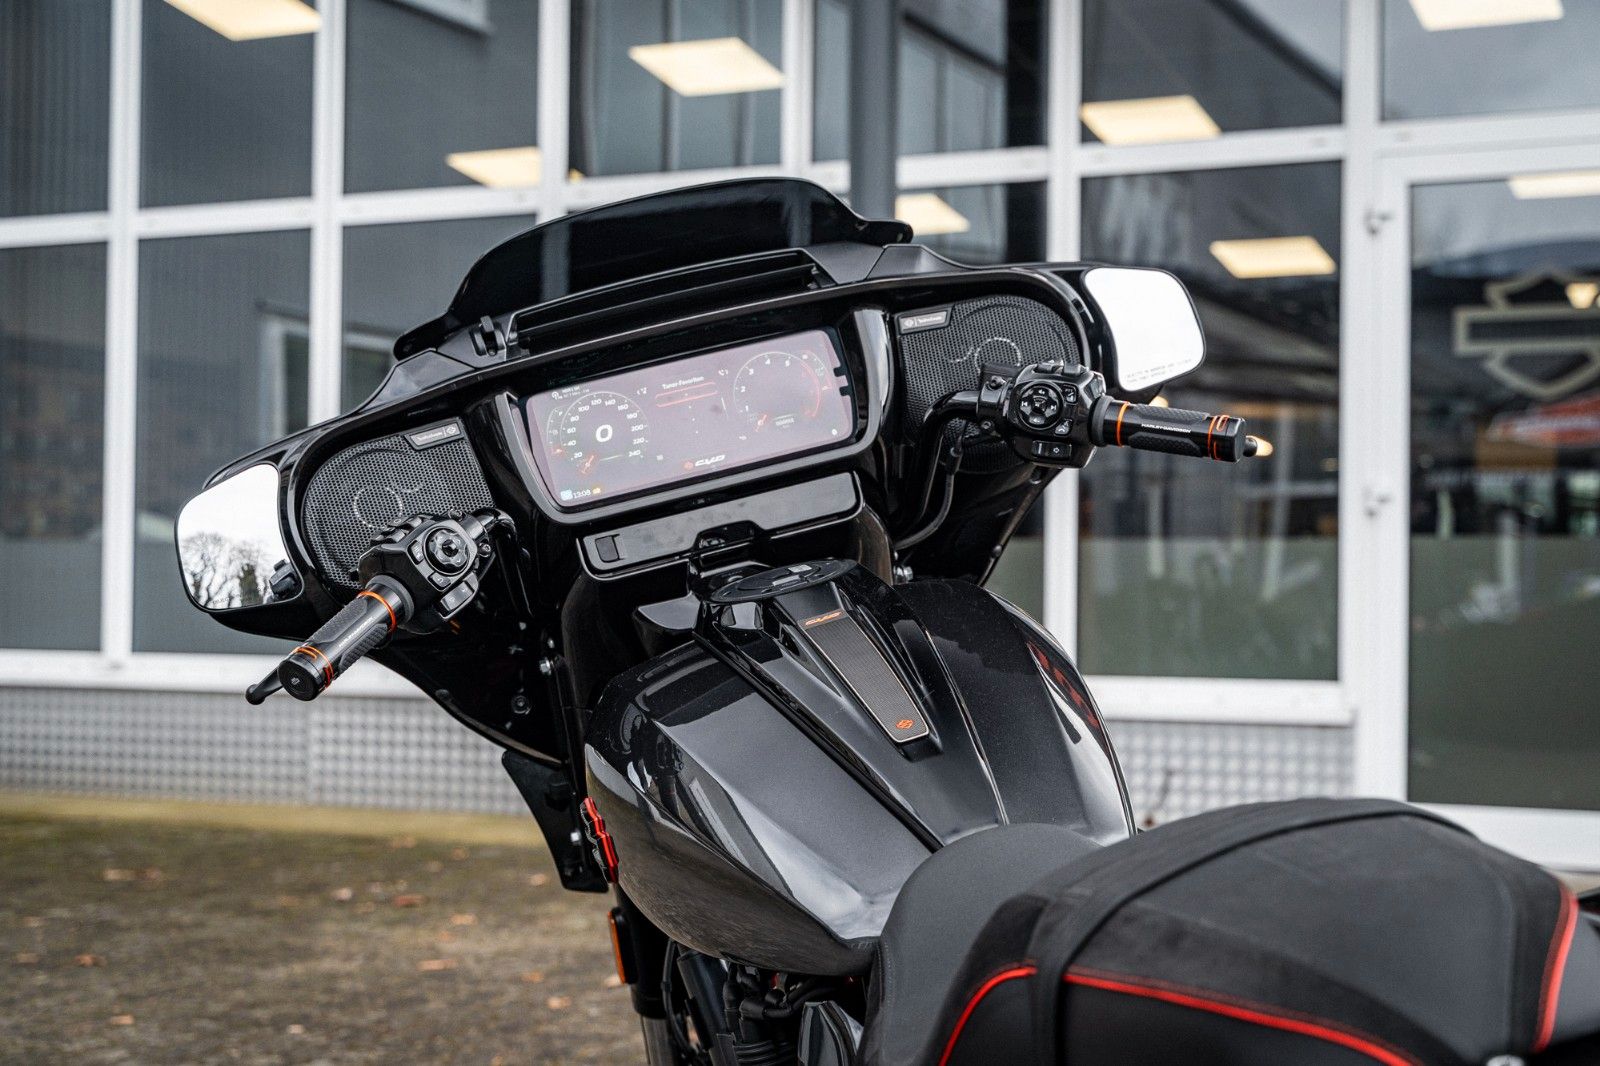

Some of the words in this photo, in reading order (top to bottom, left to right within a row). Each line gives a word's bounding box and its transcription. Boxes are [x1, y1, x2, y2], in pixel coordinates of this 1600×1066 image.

[631, 424, 644, 432] 200
[596, 424, 613, 443] 0
[633, 437, 645, 445] 220
